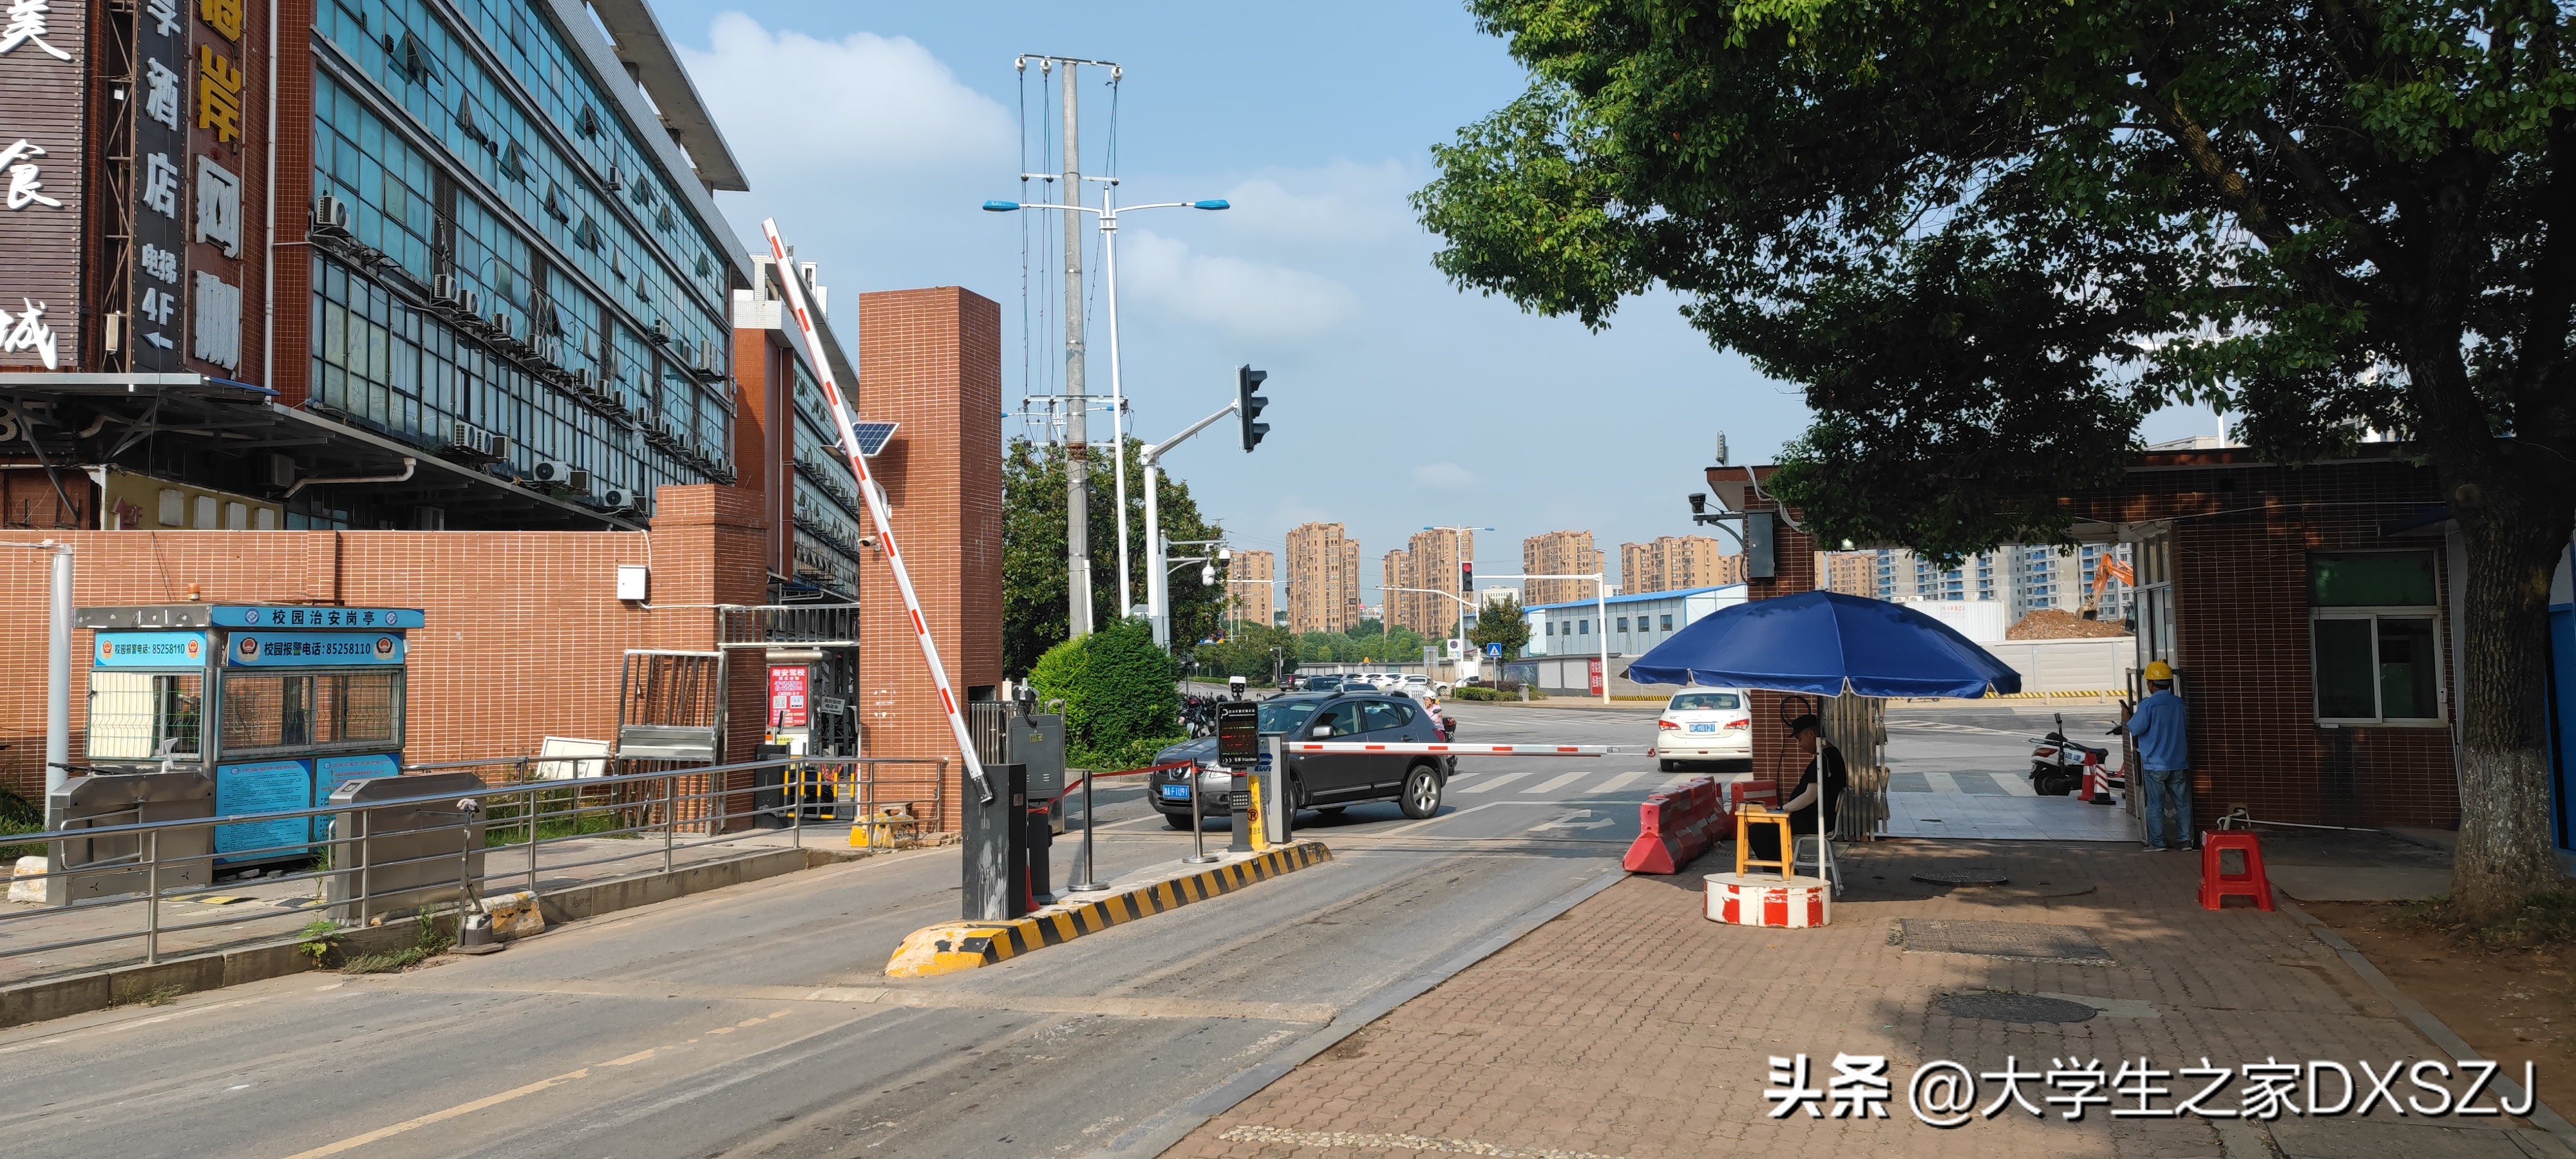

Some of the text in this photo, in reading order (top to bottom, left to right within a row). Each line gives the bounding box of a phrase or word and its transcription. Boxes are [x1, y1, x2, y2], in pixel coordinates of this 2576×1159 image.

[142, 243, 177, 285] 电梯
[142, 287, 174, 325] 4F
[273, 609, 375, 626] 校园治安岗亭
